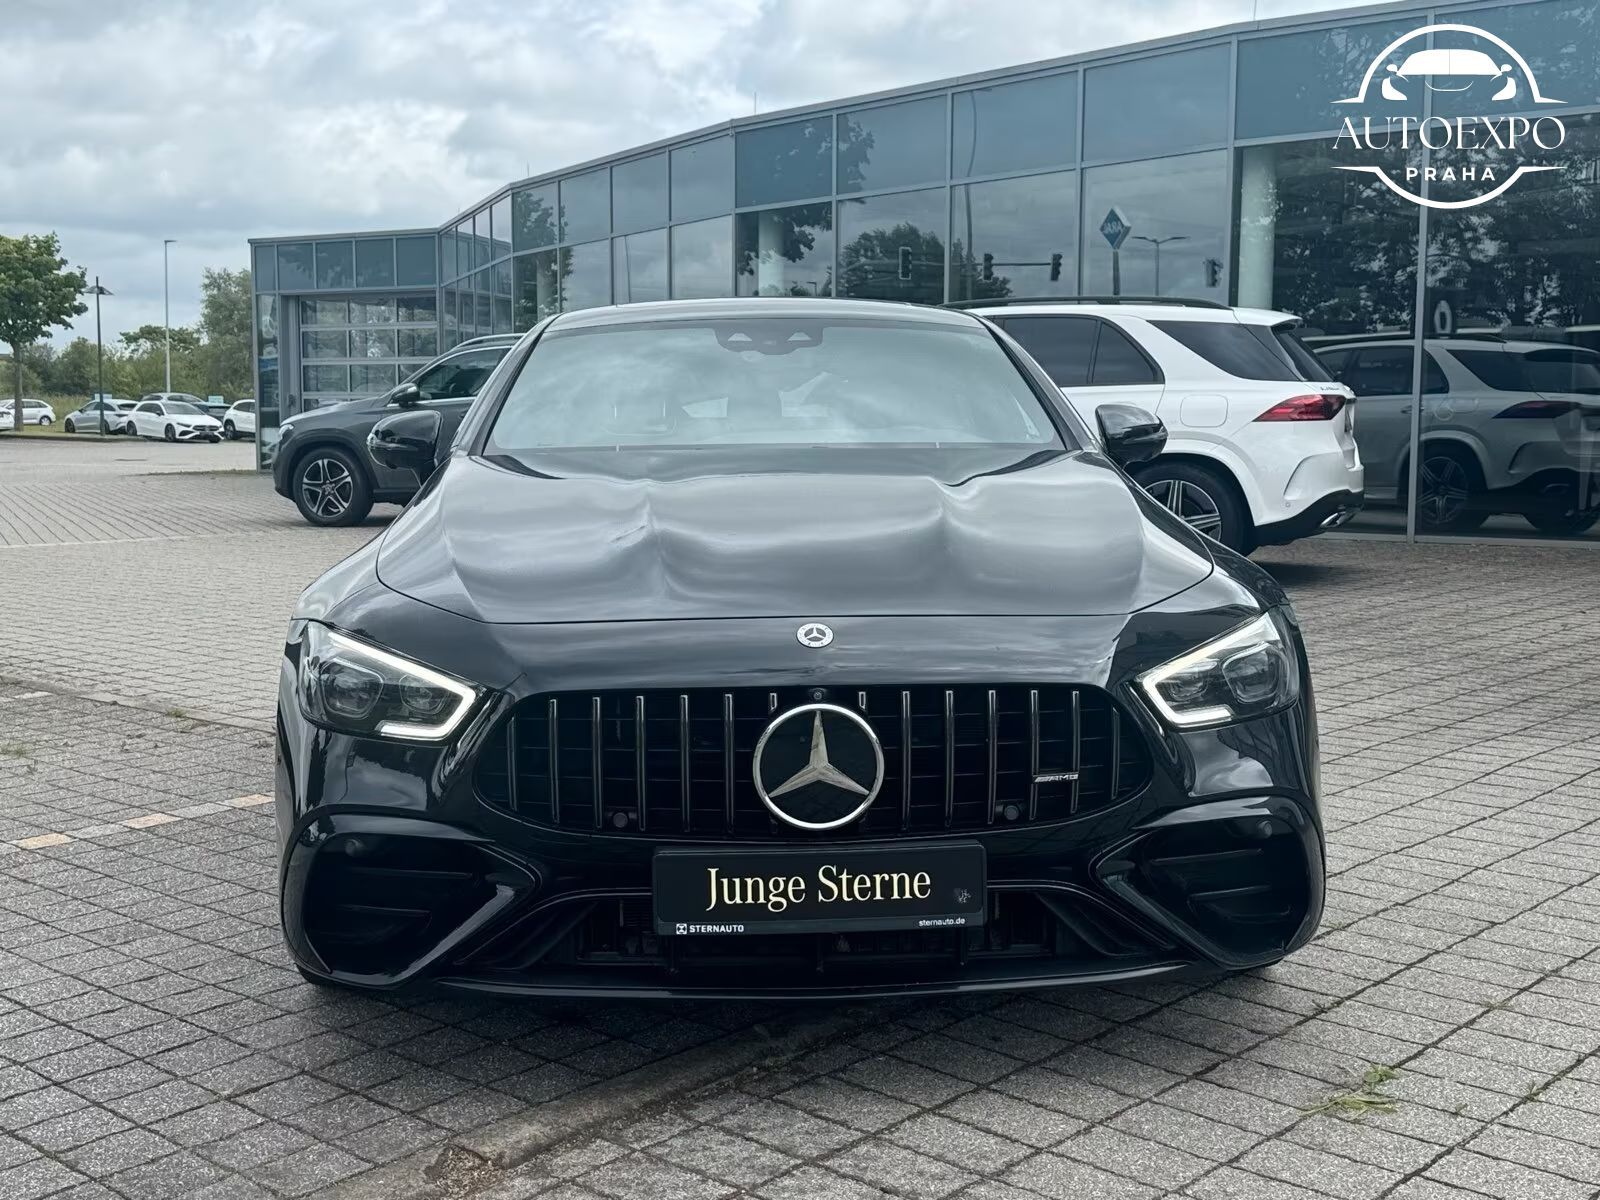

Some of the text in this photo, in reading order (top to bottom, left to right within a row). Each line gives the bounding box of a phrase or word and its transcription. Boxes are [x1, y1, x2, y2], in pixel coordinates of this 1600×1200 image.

[705, 864, 932, 913] Junge Sterne
[918, 917, 966, 927] sternauto.de
[688, 924, 745, 933] STERNAUTO
